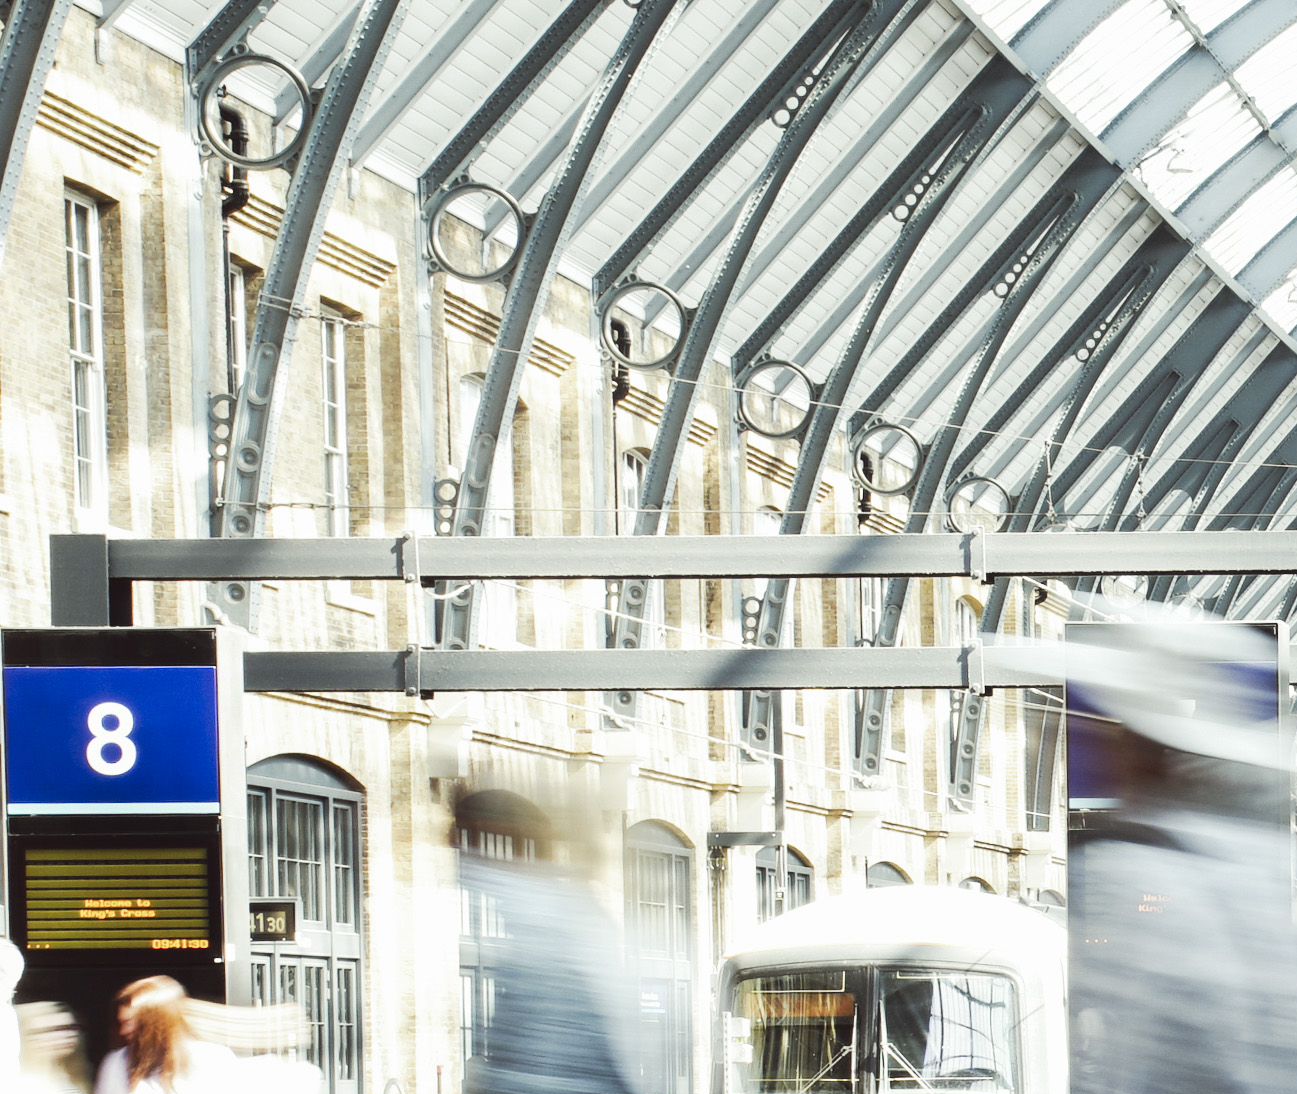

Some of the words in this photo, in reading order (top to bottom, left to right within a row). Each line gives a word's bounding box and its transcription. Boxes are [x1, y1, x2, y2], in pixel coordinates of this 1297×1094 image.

[86, 701, 137, 776] 8
[84, 899, 133, 908] Welcome
[135, 899, 151, 908] to
[79, 909, 116, 919] King's
[120, 909, 156, 918] Cross
[152, 939, 209, 950] 09:41:30
